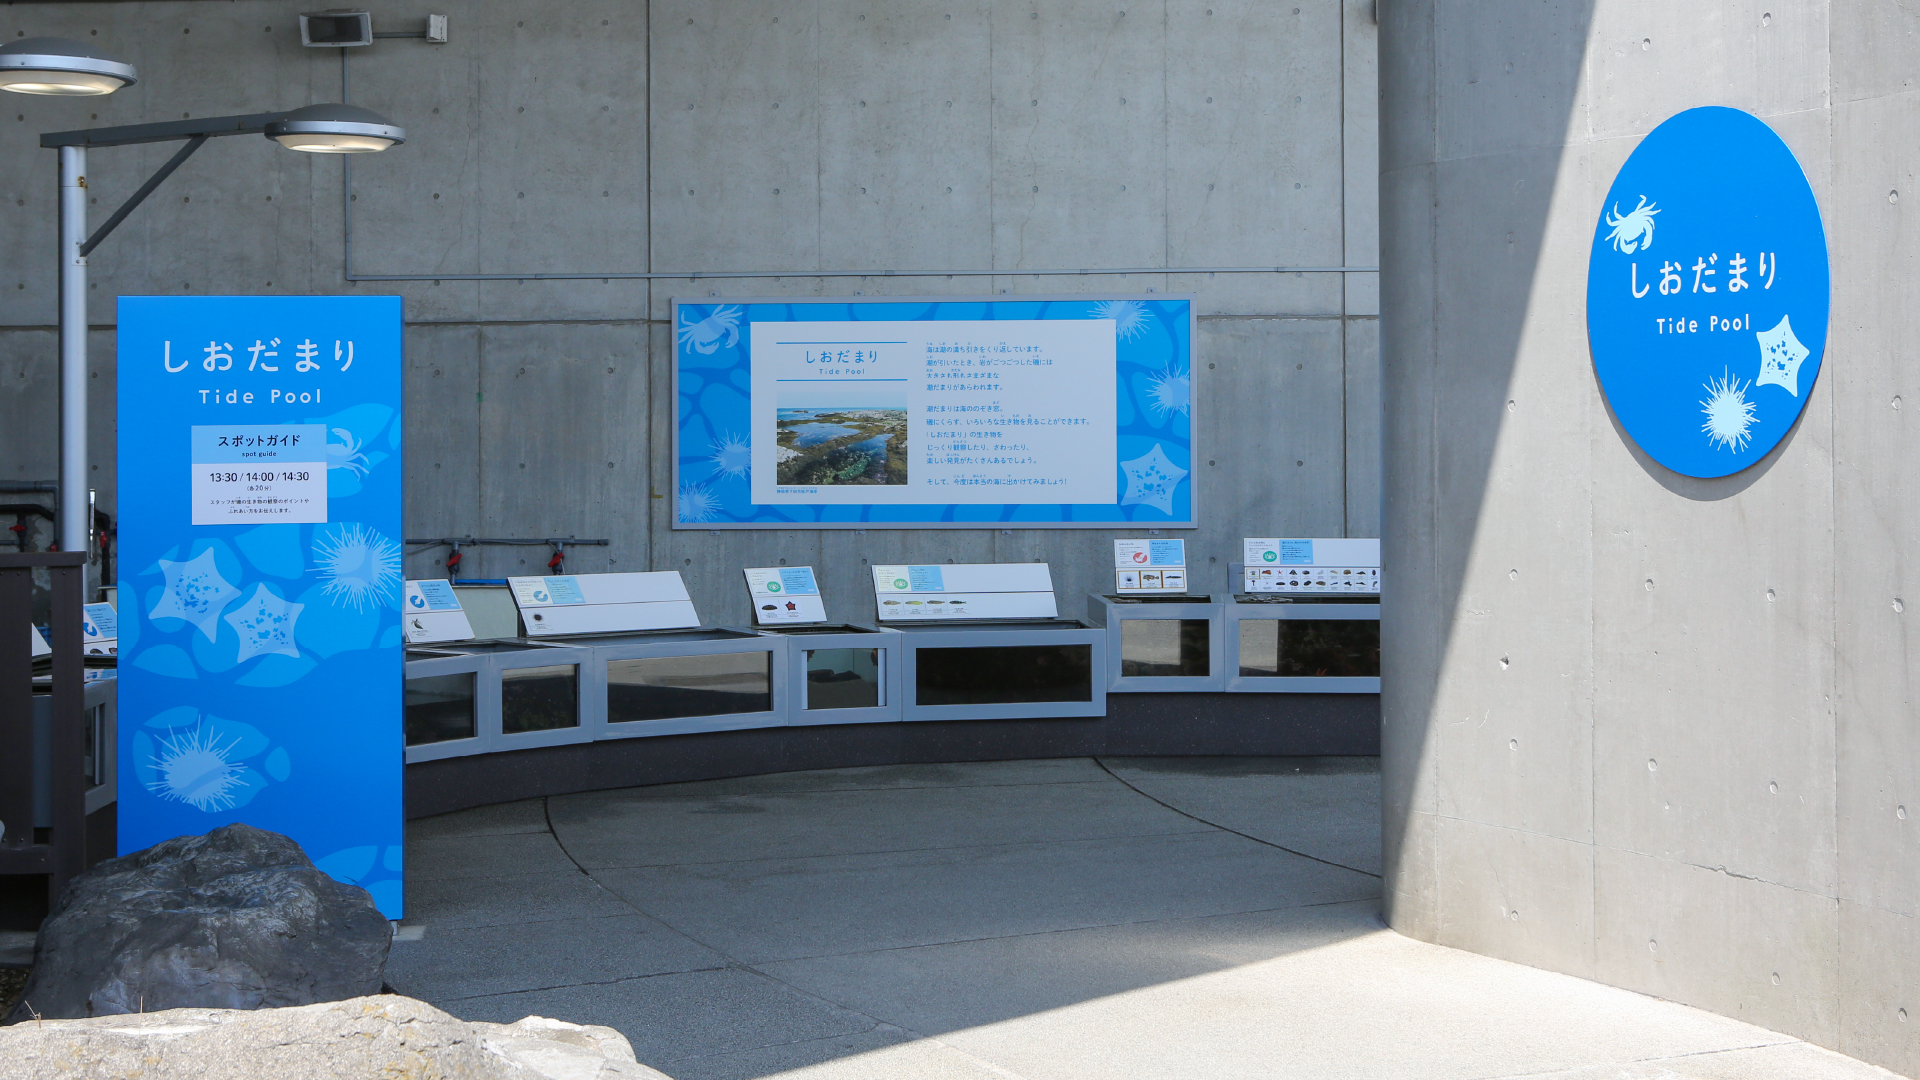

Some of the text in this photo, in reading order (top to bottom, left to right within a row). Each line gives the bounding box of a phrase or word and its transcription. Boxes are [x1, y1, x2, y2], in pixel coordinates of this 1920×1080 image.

[1632, 252, 1776, 298] しおだまり
[1656, 313, 1750, 334] Tide Pool
[165, 337, 353, 372] しおだまり
[806, 350, 878, 363] しおだまり
[926, 383, 1003, 391] 潮だまりがあらわれます。
[199, 389, 320, 403] Tide Pool
[219, 435, 300, 447] スポットガイド
[258, 450, 277, 458] guide
[210, 473, 237, 482] 13:30
[247, 472, 273, 481] 14:00
[283, 472, 309, 481] 14:30
